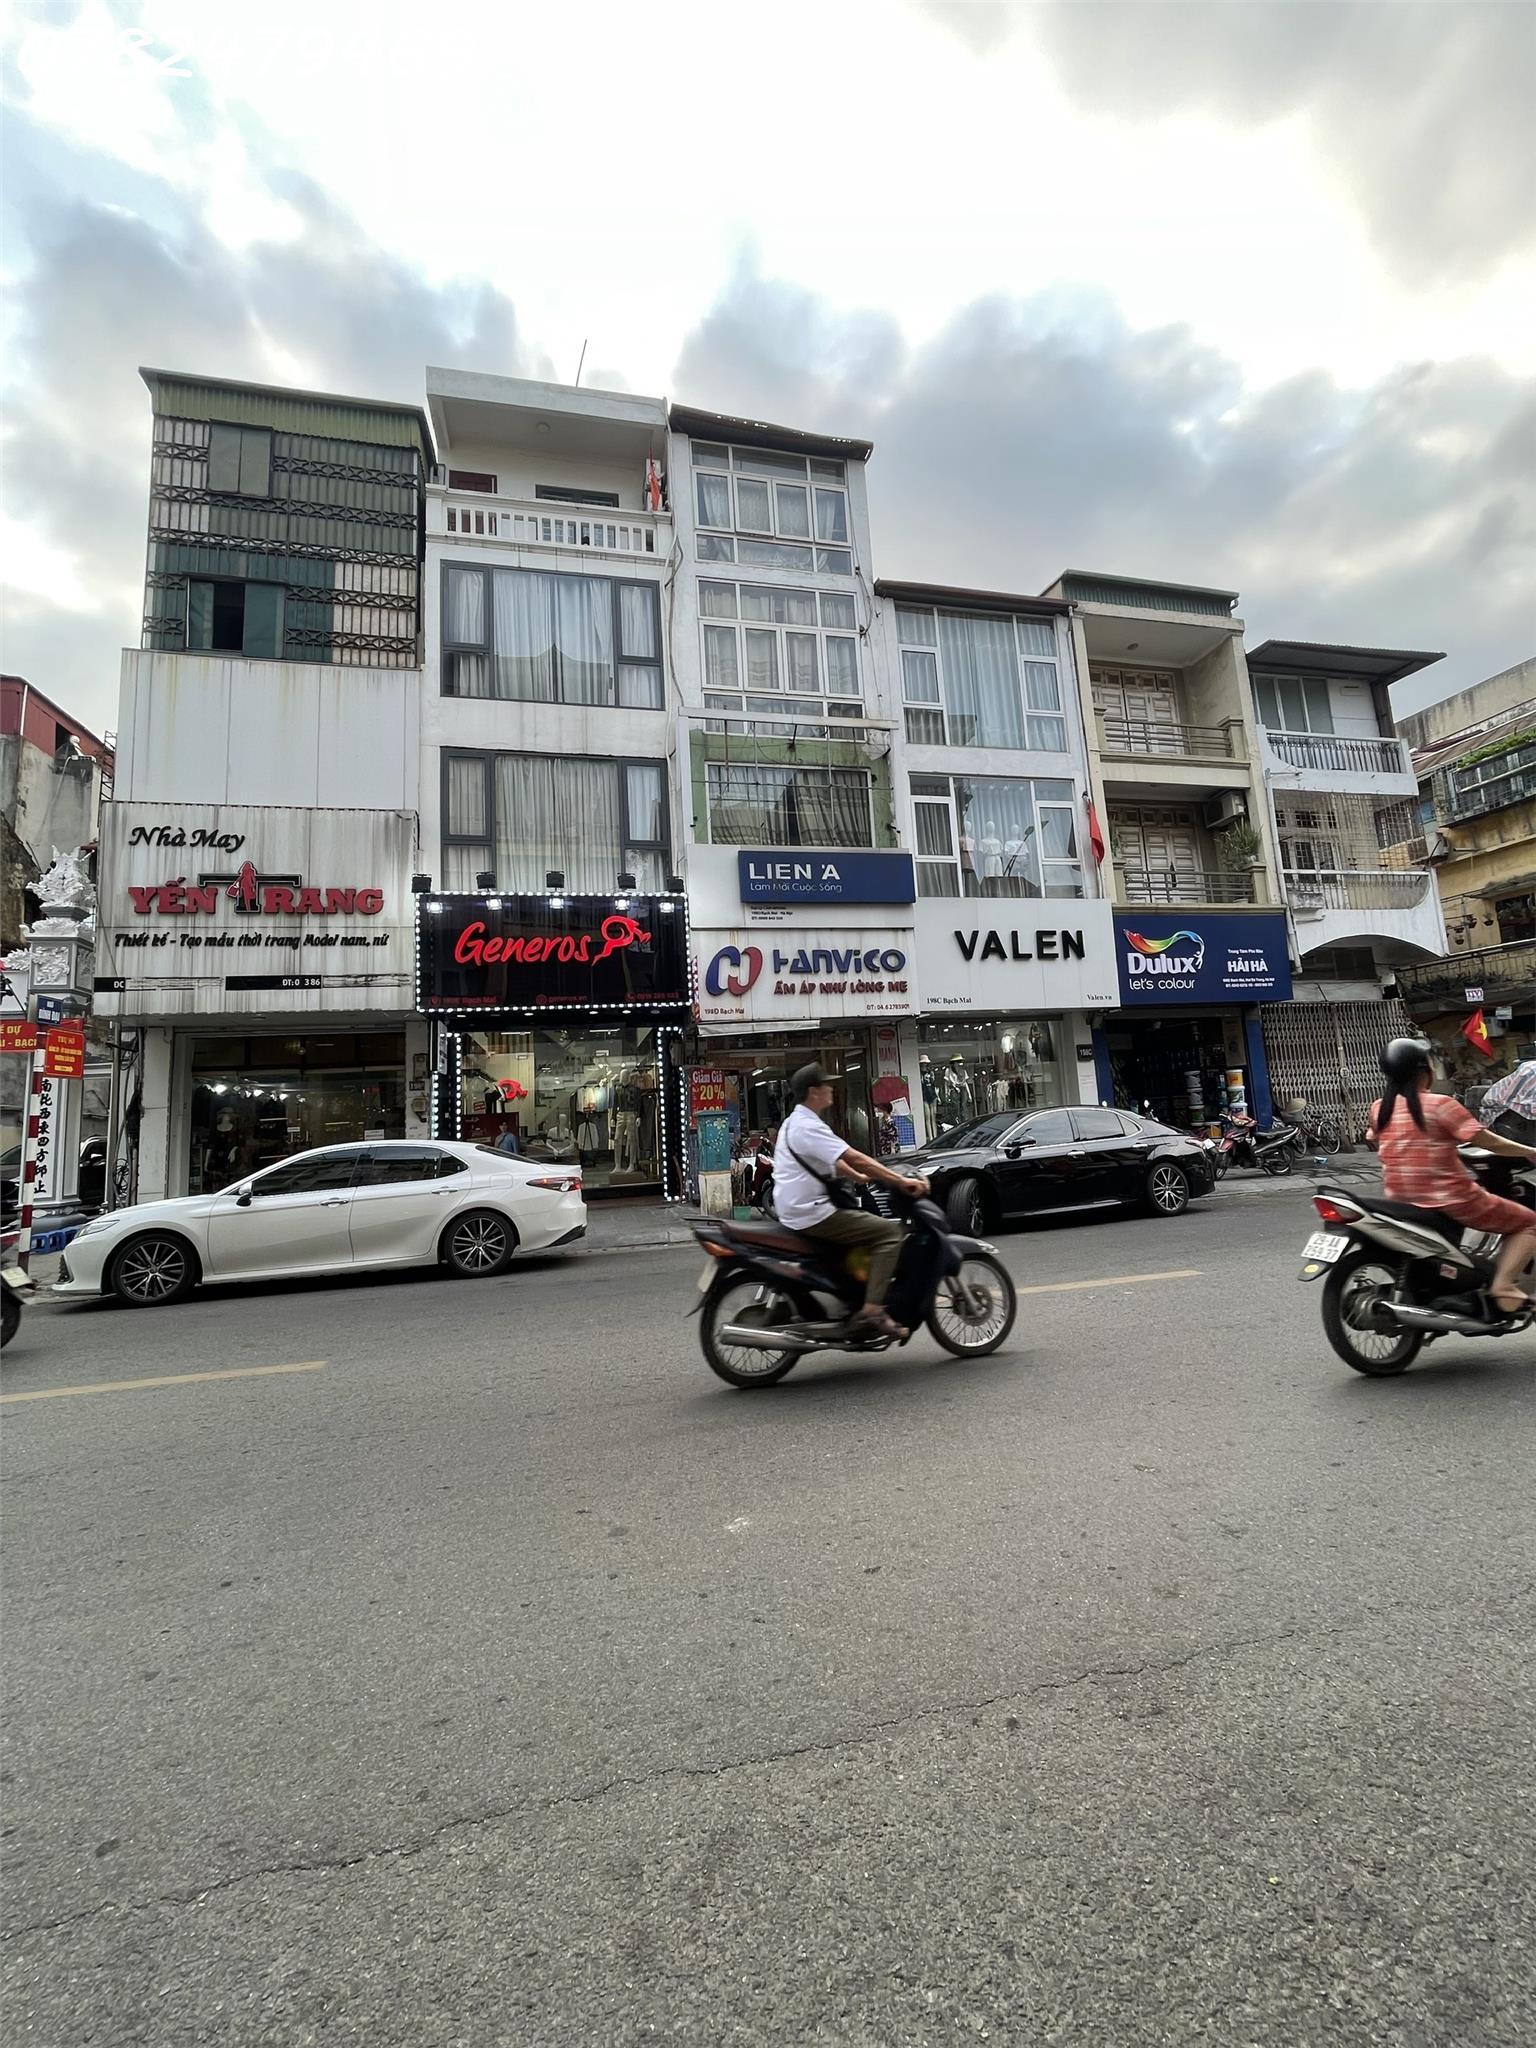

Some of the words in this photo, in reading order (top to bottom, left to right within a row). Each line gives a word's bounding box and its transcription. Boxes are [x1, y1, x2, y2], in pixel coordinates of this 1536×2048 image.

[128, 826, 187, 847] Nhà
[190, 829, 245, 853] May
[749, 863, 812, 880] LIEN
[128, 877, 218, 914] YẾN
[264, 935, 300, 950] trang
[303, 934, 339, 946] Model
[340, 936, 371, 947] nam,
[454, 921, 592, 967] Generos
[954, 930, 1085, 961] VALEN
[1127, 953, 1196, 974] Dulux
[1227, 957, 1249, 972] HẢI
[1250, 958, 1268, 972] HÀ
[1129, 977, 1154, 990] let's
[1158, 977, 1195, 989] colour
[700, 1085, 725, 1100] 20%
